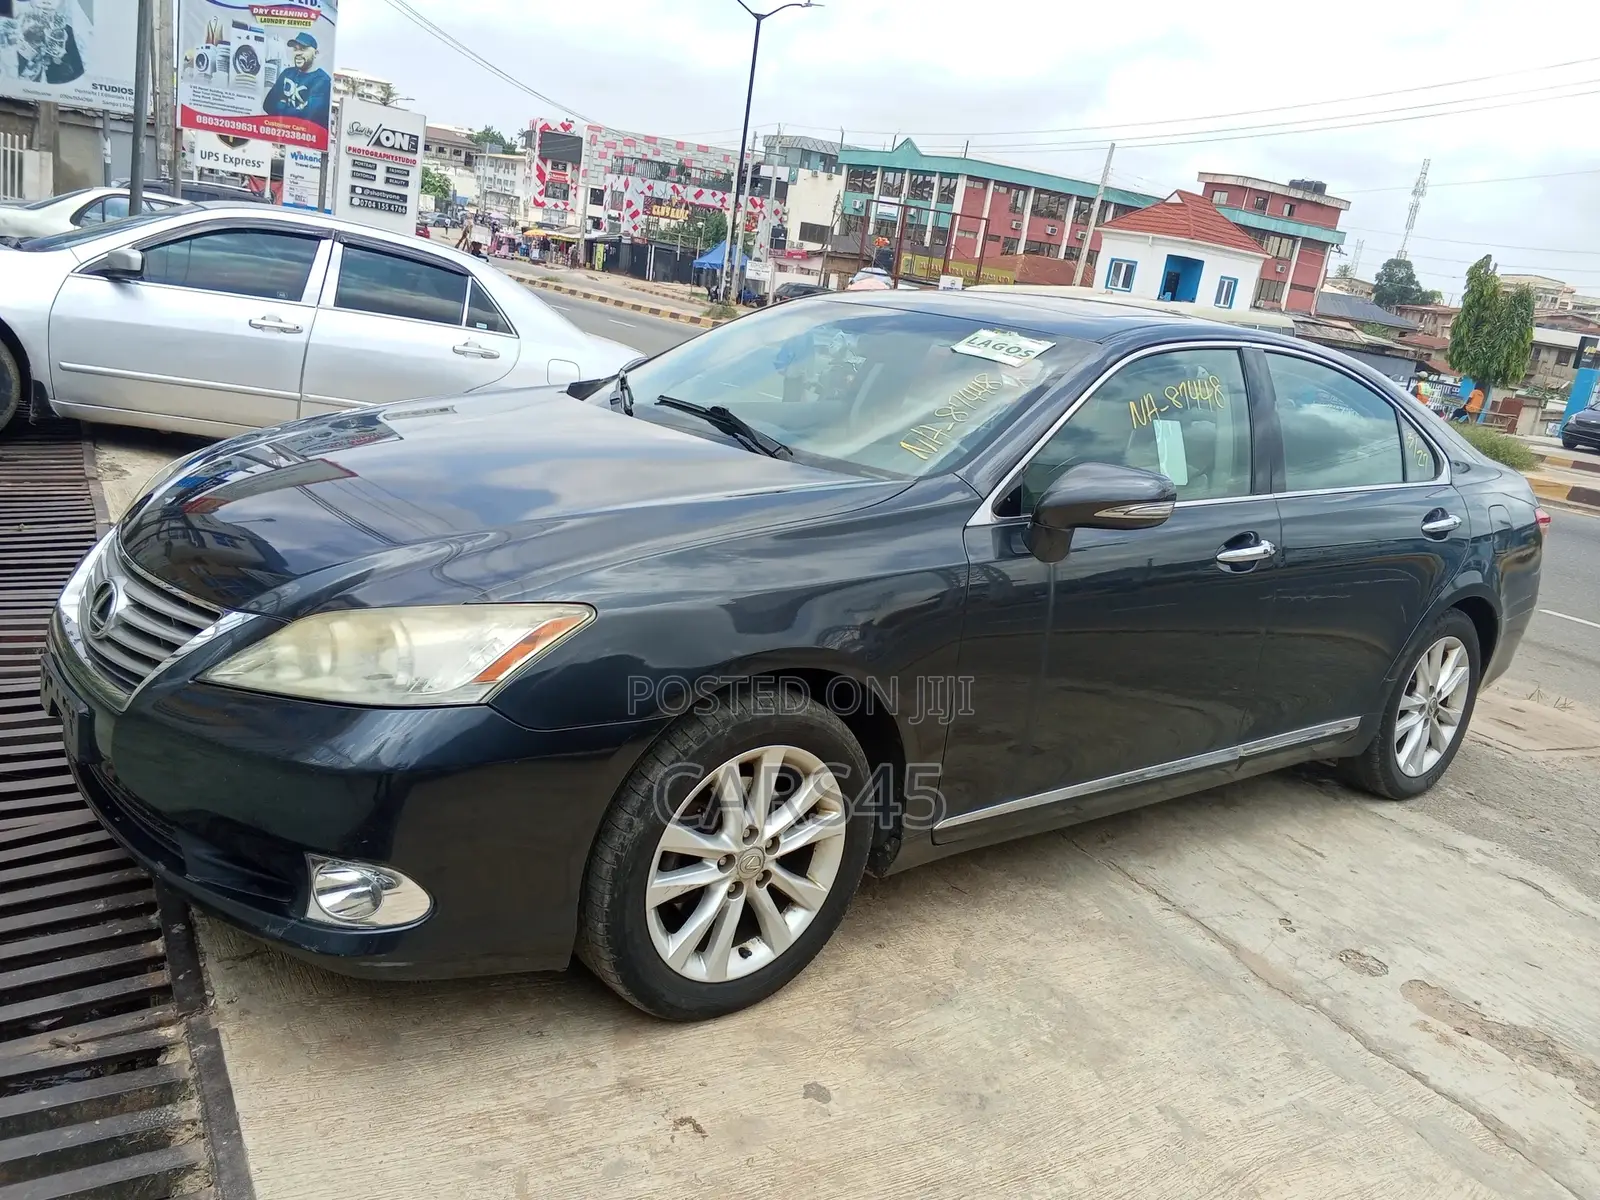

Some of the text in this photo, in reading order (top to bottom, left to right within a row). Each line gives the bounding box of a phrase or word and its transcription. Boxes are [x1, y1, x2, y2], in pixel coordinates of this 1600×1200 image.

[252, 7, 269, 15] DRY
[270, 9, 309, 18] CLEANING
[260, 17, 312, 27] LAUNDRY SERVICES
[91, 82, 134, 96] STUDIOS
[195, 115, 317, 143] 08032039631, 08027338404
[263, 119, 291, 130] Customer
[200, 149, 263, 168] UPS Express
[353, 172, 375, 180] EDITORIAL
[360, 199, 376, 208] 0704
[377, 202, 389, 211] 155
[967, 336, 1035, 358] LAGOS
